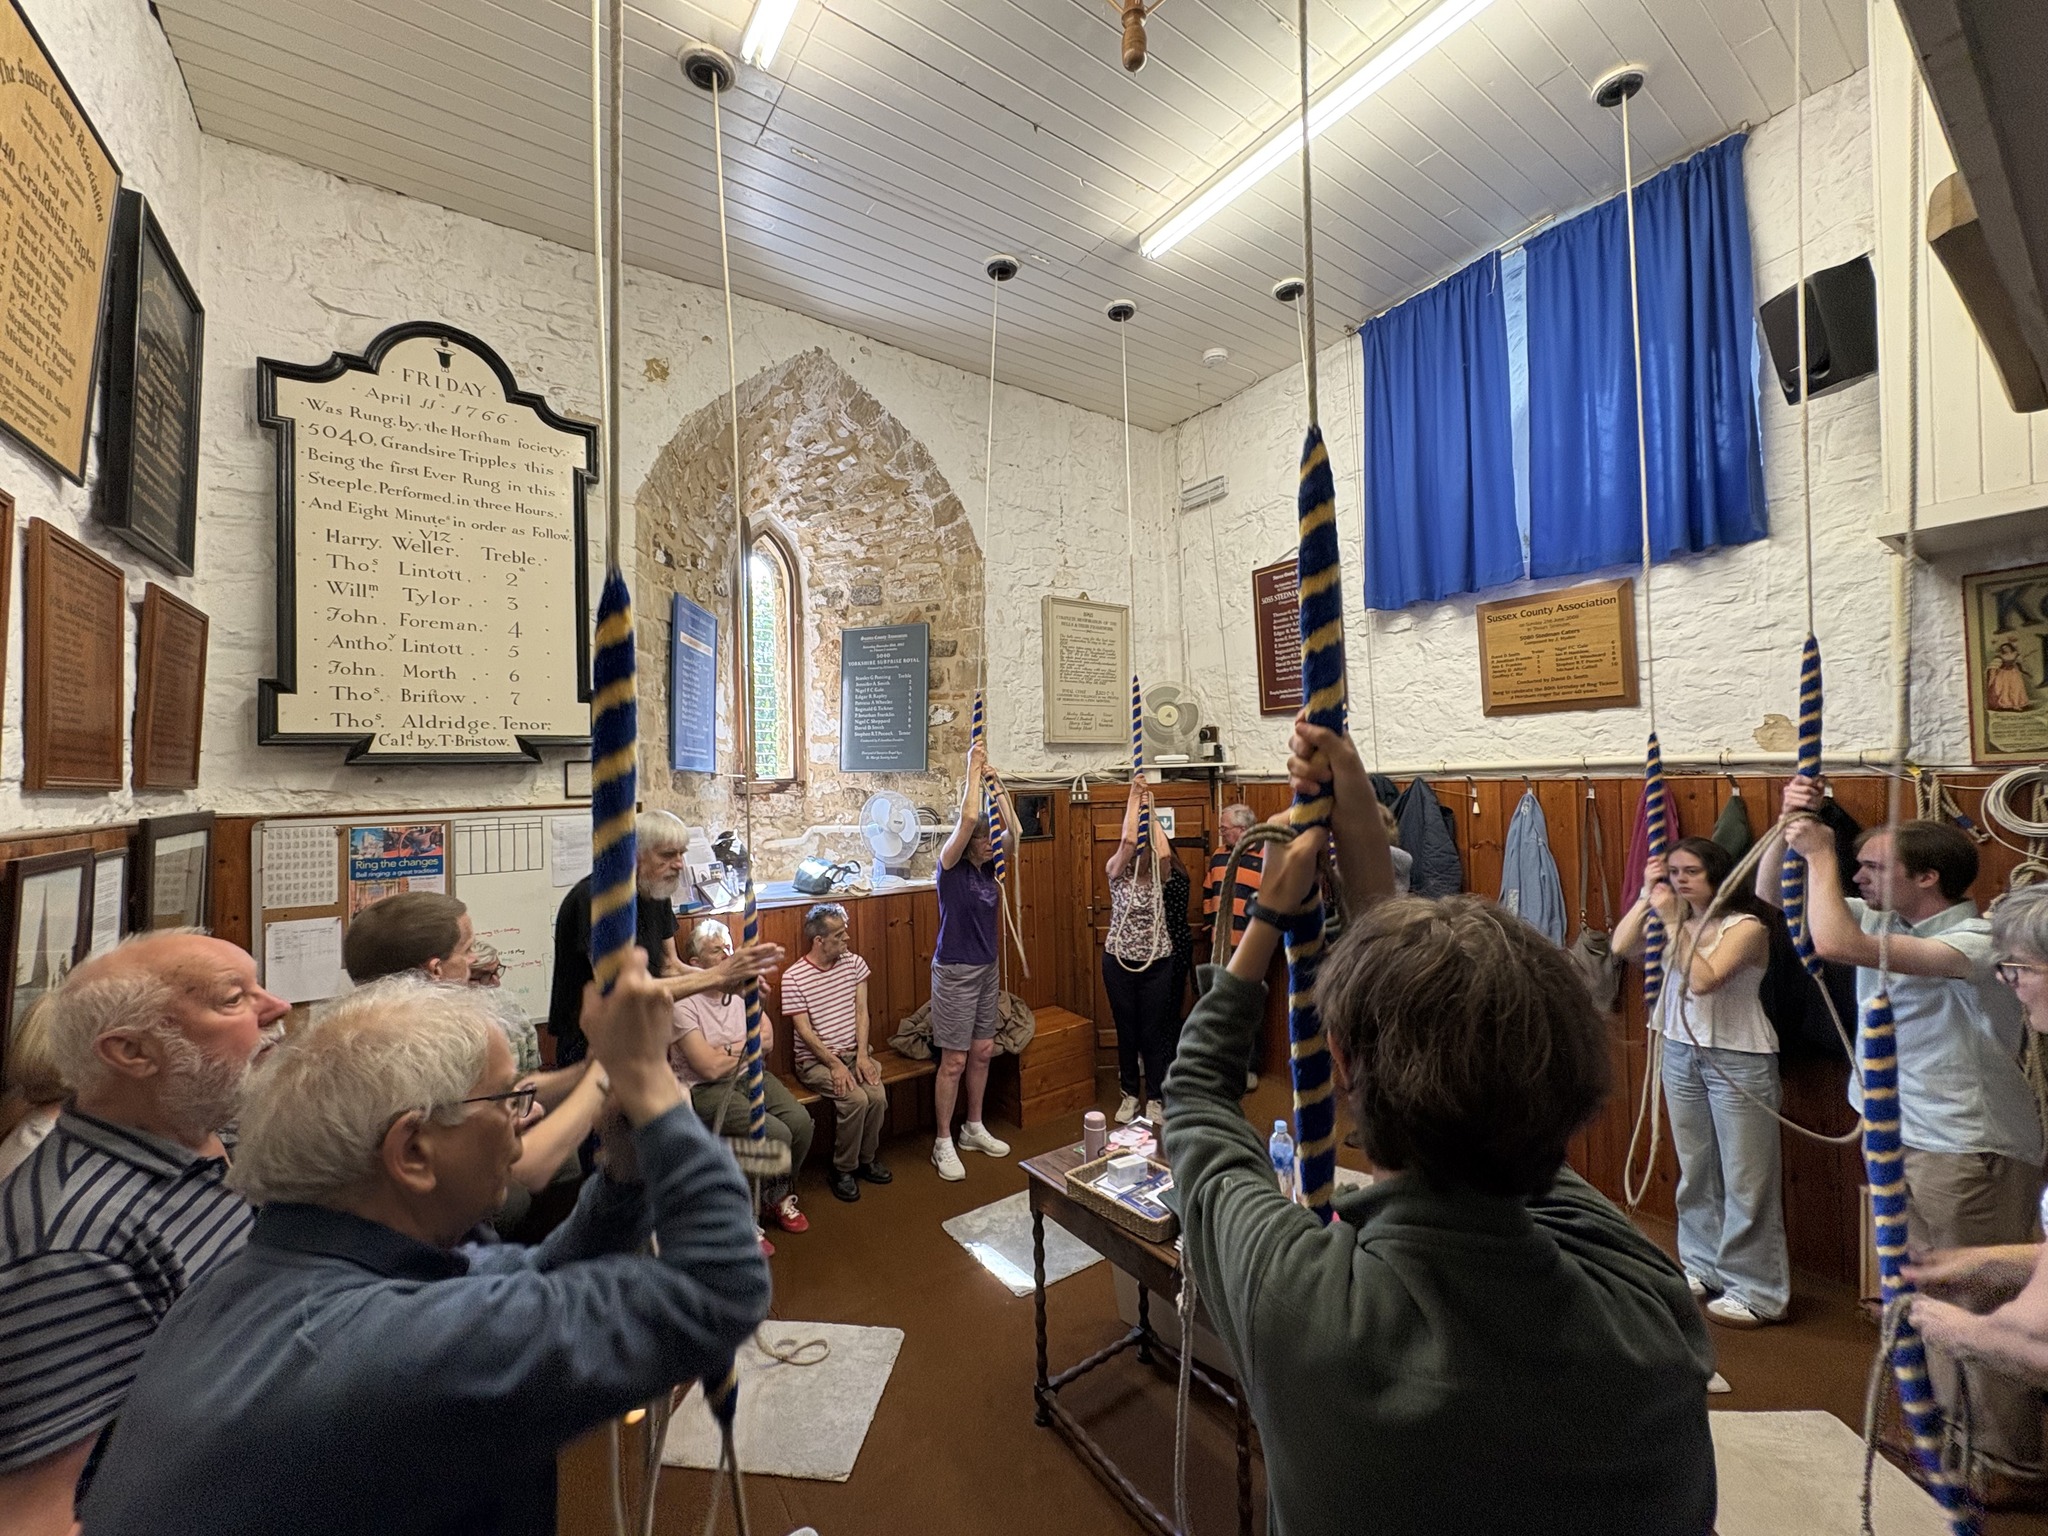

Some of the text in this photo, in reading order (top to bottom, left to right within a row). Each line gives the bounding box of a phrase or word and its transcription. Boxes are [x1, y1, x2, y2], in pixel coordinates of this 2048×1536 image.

[18, 160, 68, 231] Grandsire
[402, 368, 488, 398] FRIDAY
[364, 386, 411, 406] April
[306, 398, 344, 416] Was
[424, 420, 448, 436] the
[381, 435, 456, 460] Grandsire
[459, 448, 517, 470] Tripples
[524, 461, 554, 476] this
[308, 446, 556, 497] Being the first Ever Rung in this
[456, 494, 470, 506] in
[473, 497, 512, 512] three
[308, 498, 342, 512] And
[348, 500, 390, 520] Eight
[452, 517, 466, 528] in
[470, 520, 506, 534] order
[512, 526, 526, 536] as
[398, 561, 463, 582] Lintott
[402, 587, 460, 606] Tylor
[506, 596, 519, 612] 3
[1487, 612, 1518, 624] Sussex
[1520, 606, 1554, 618] County
[1556, 597, 1616, 612] Association
[508, 621, 522, 638] 4
[402, 638, 463, 656] Lintott
[508, 644, 520, 658] 5
[402, 664, 456, 680] Morth
[508, 670, 520, 682] 6
[510, 691, 520, 706] 7
[356, 858, 439, 870] Ring the changes
